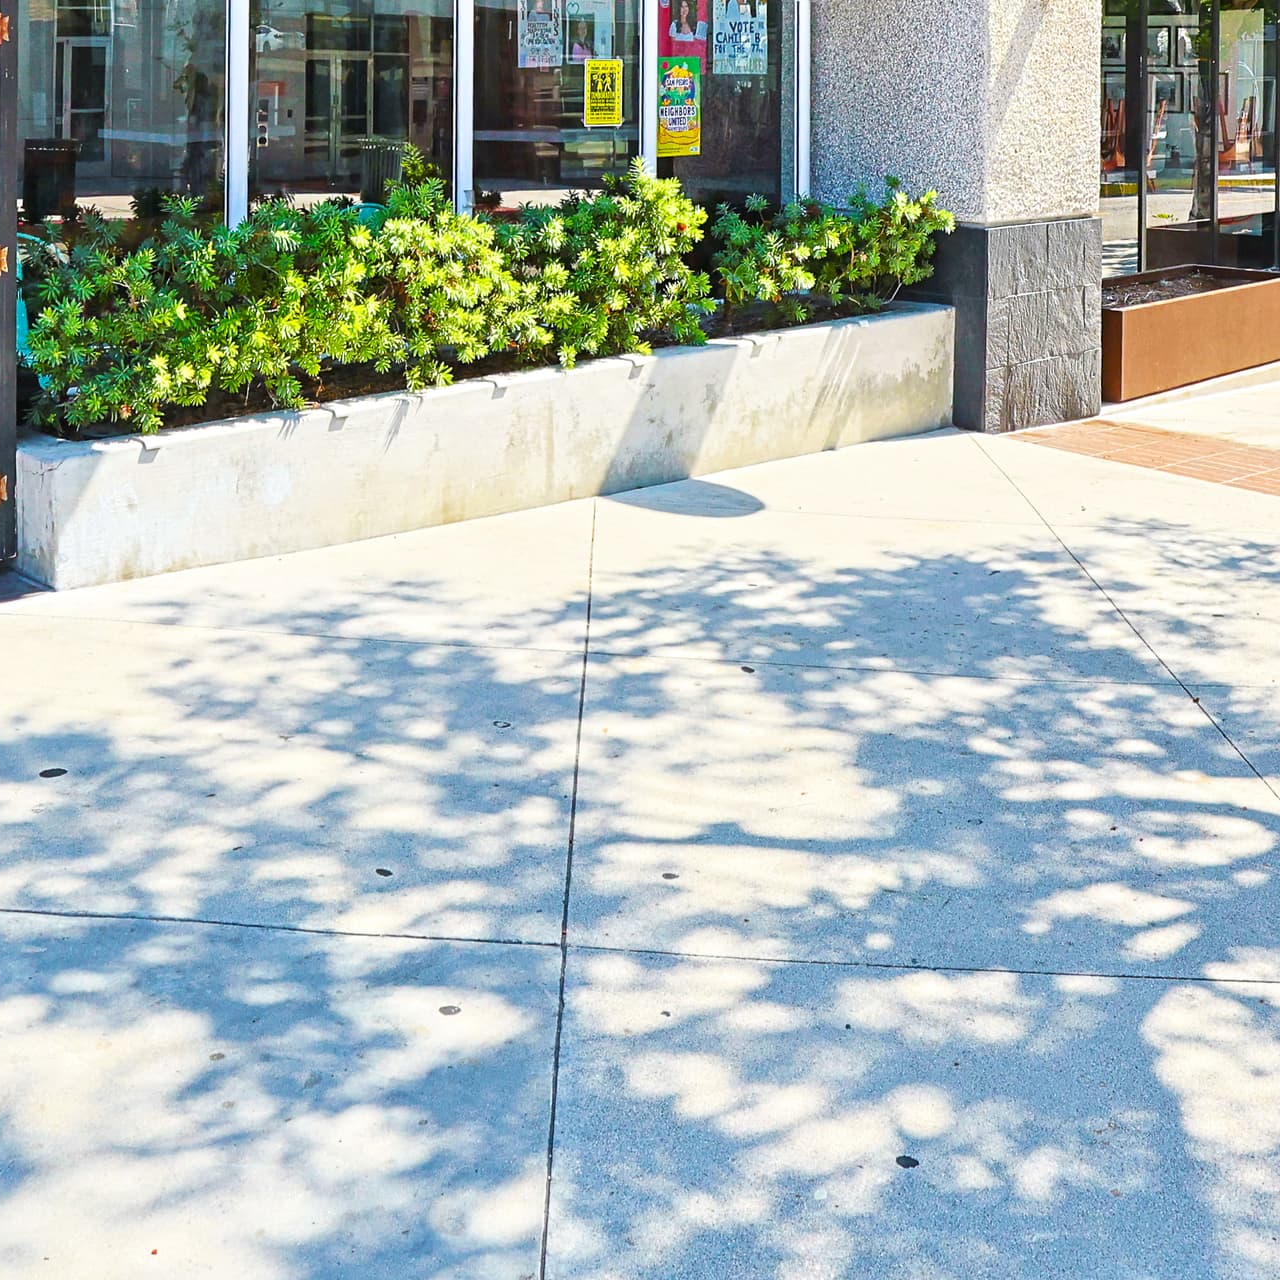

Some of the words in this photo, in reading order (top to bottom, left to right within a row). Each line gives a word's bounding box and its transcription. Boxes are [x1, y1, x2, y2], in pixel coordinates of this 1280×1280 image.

[729, 21, 754, 33] VOTE
[660, 106, 696, 117] NEIGHBORS
[668, 117, 687, 126] UNITED
